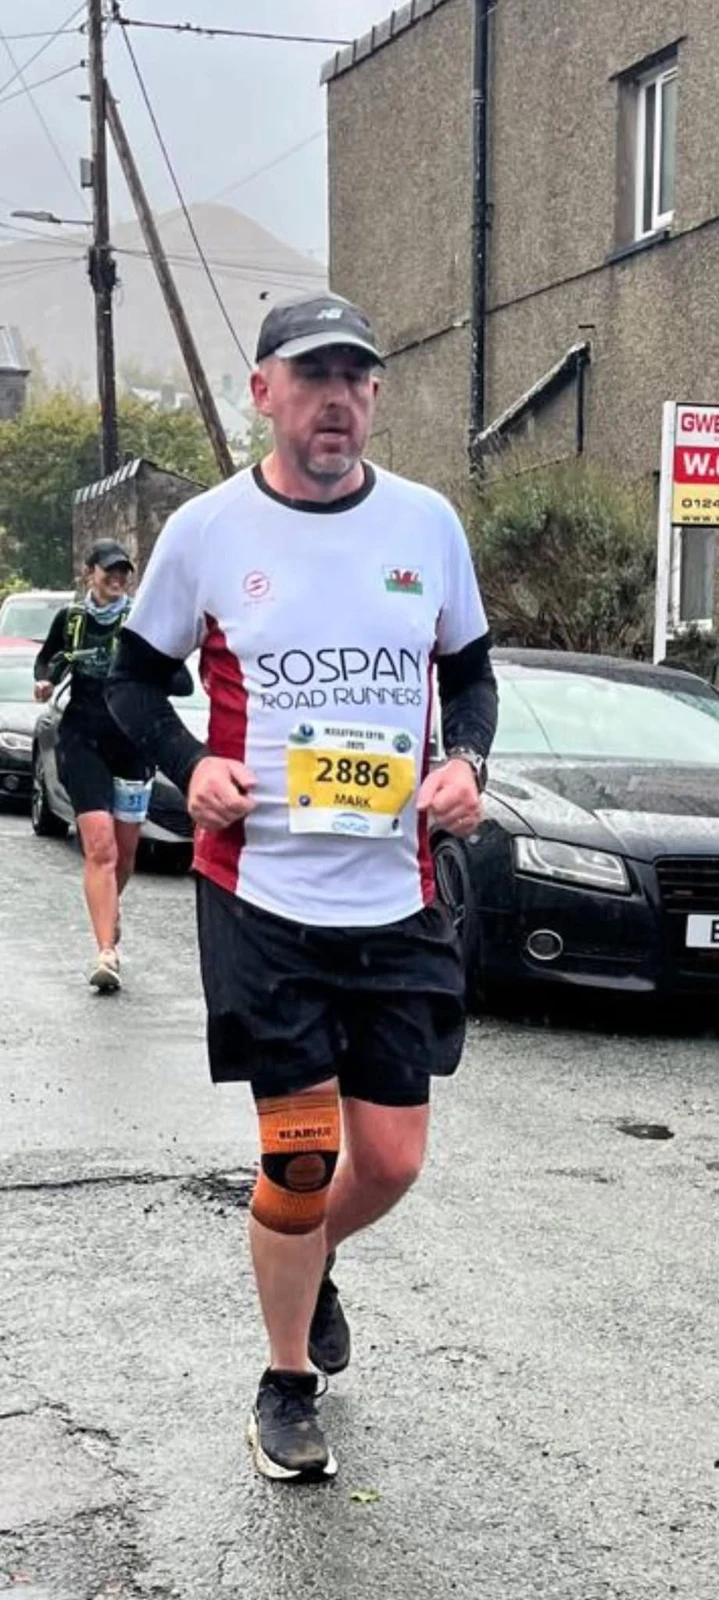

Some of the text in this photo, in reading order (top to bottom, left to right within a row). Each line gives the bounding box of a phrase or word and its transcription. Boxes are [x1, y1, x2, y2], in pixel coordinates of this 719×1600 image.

[683, 452, 719, 476] W.
[257, 647, 421, 688] SOSPAN
[261, 687, 422, 710] ROAD RUNNERS
[316, 757, 390, 788] 2886
[333, 793, 372, 808] MARK
